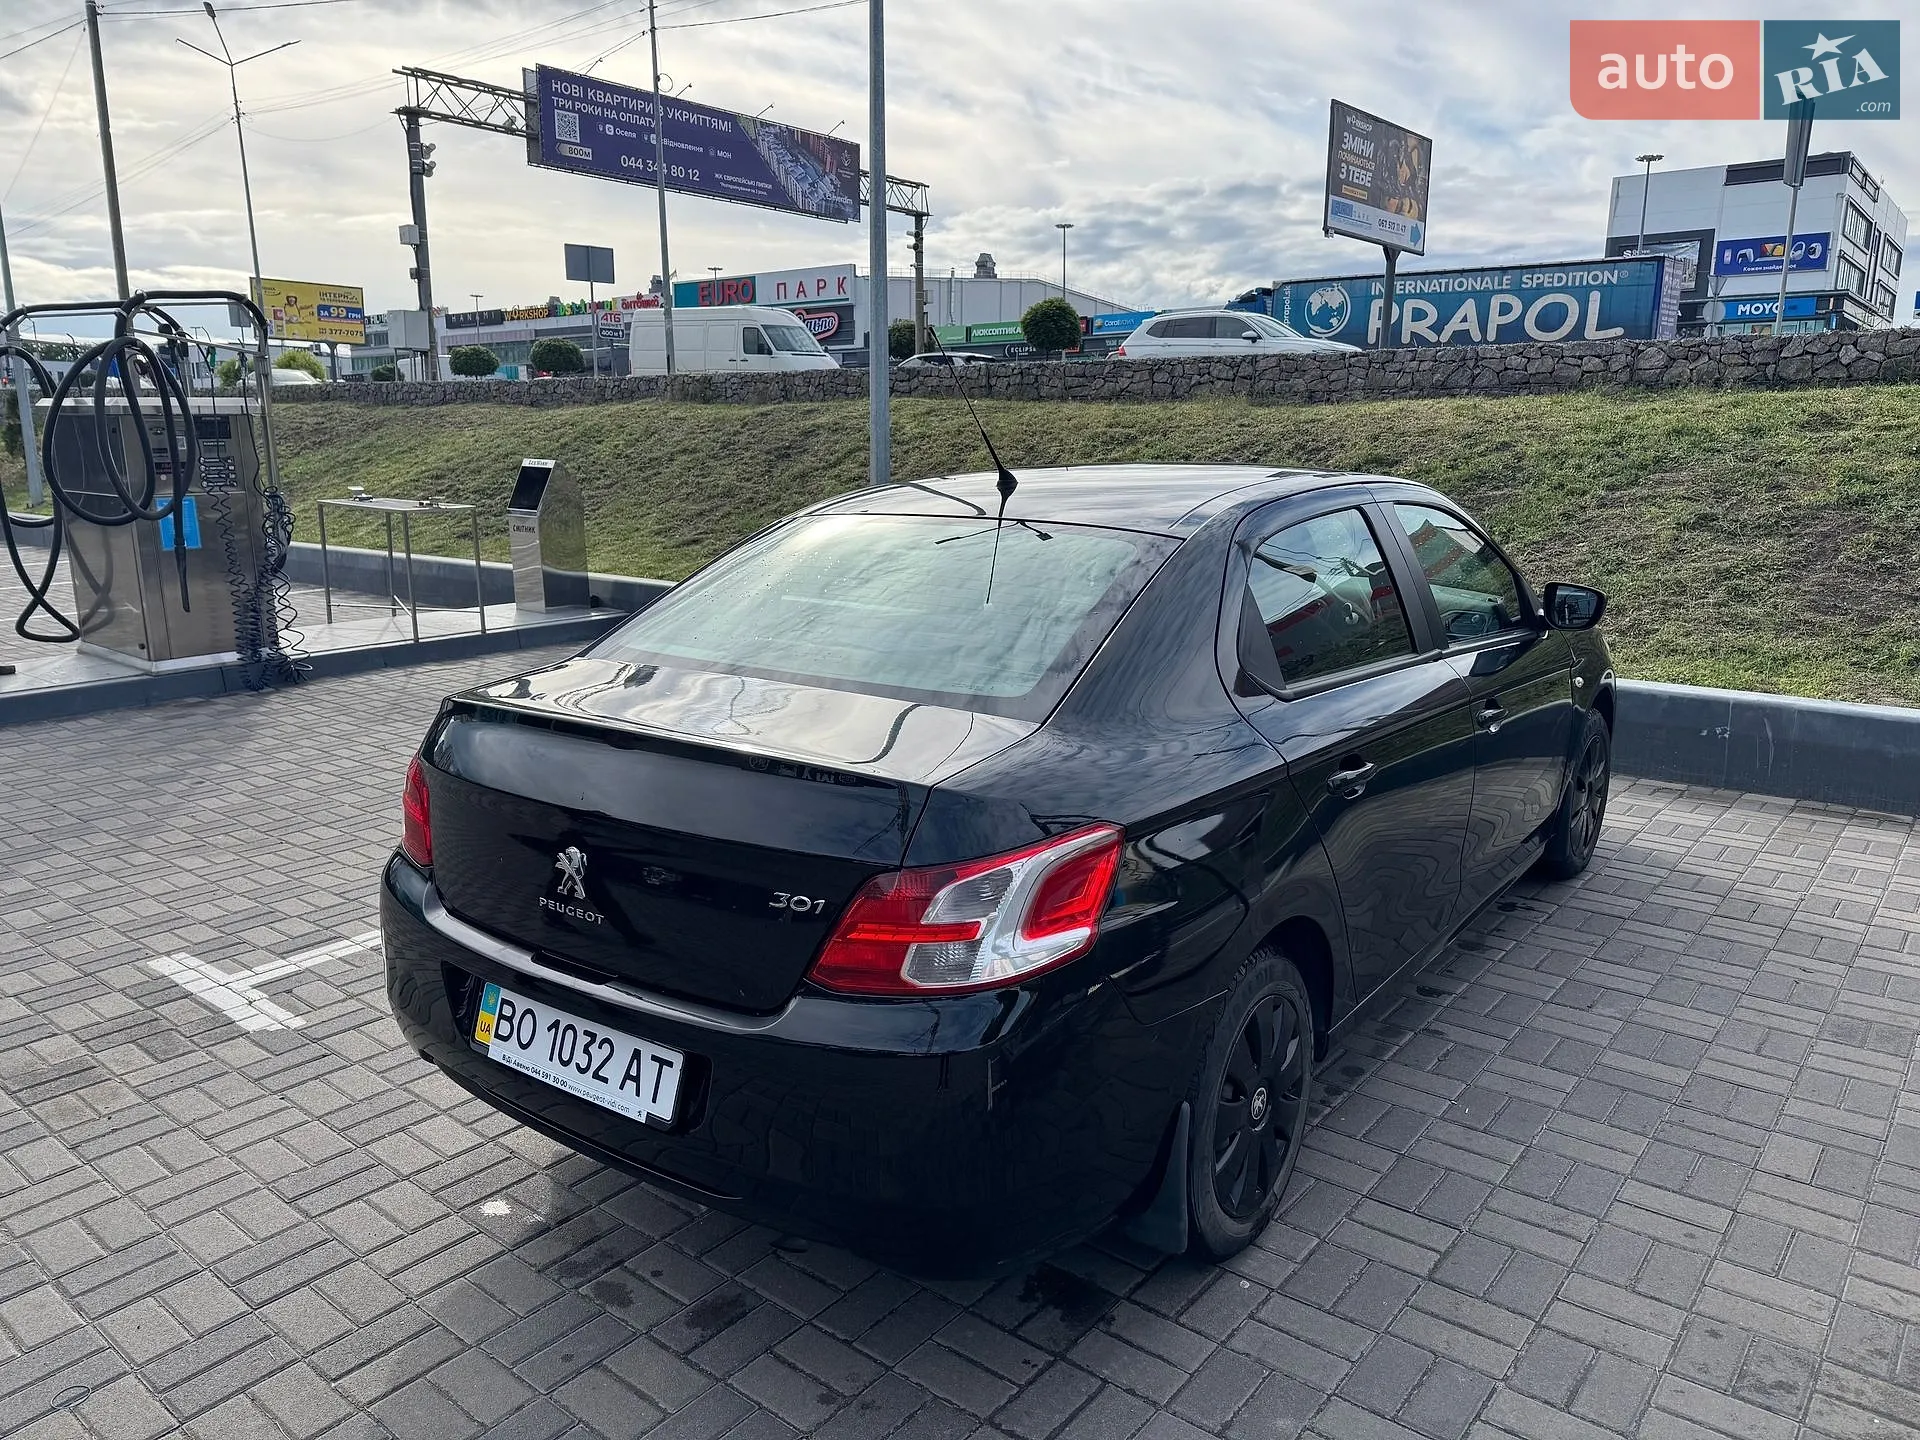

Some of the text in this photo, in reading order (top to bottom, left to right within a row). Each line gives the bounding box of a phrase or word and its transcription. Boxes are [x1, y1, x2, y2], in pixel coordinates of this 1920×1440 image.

[551, 79, 584, 98] НОВІ
[587, 87, 654, 115] КВАРТИРИ
[666, 106, 732, 133] УКРИТТЯМ!
[551, 96, 573, 110] ТРИ
[574, 101, 602, 116] РОКИ
[603, 108, 618, 120] НА
[1341, 131, 1375, 159] ЗМІНИ
[621, 154, 644, 169] 044
[670, 164, 685, 178] 80
[687, 168, 700, 181] 12
[1348, 165, 1373, 187] ТЕБЕ
[698, 276, 847, 307] EURO ПАРК
[1371, 270, 1512, 296] INERNATIONALE
[330, 306, 347, 318] 99
[1367, 290, 1625, 346] PRAPOL
[539, 896, 605, 925] PEUGEOT
[768, 891, 826, 914] 301
[479, 1019, 491, 1035] UA
[494, 997, 674, 1104] BO 1032 AT
[530, 1066, 541, 1077] 044
[541, 1070, 552, 1081] 591
[552, 1075, 560, 1085] 30
[559, 1079, 568, 1088] 00
